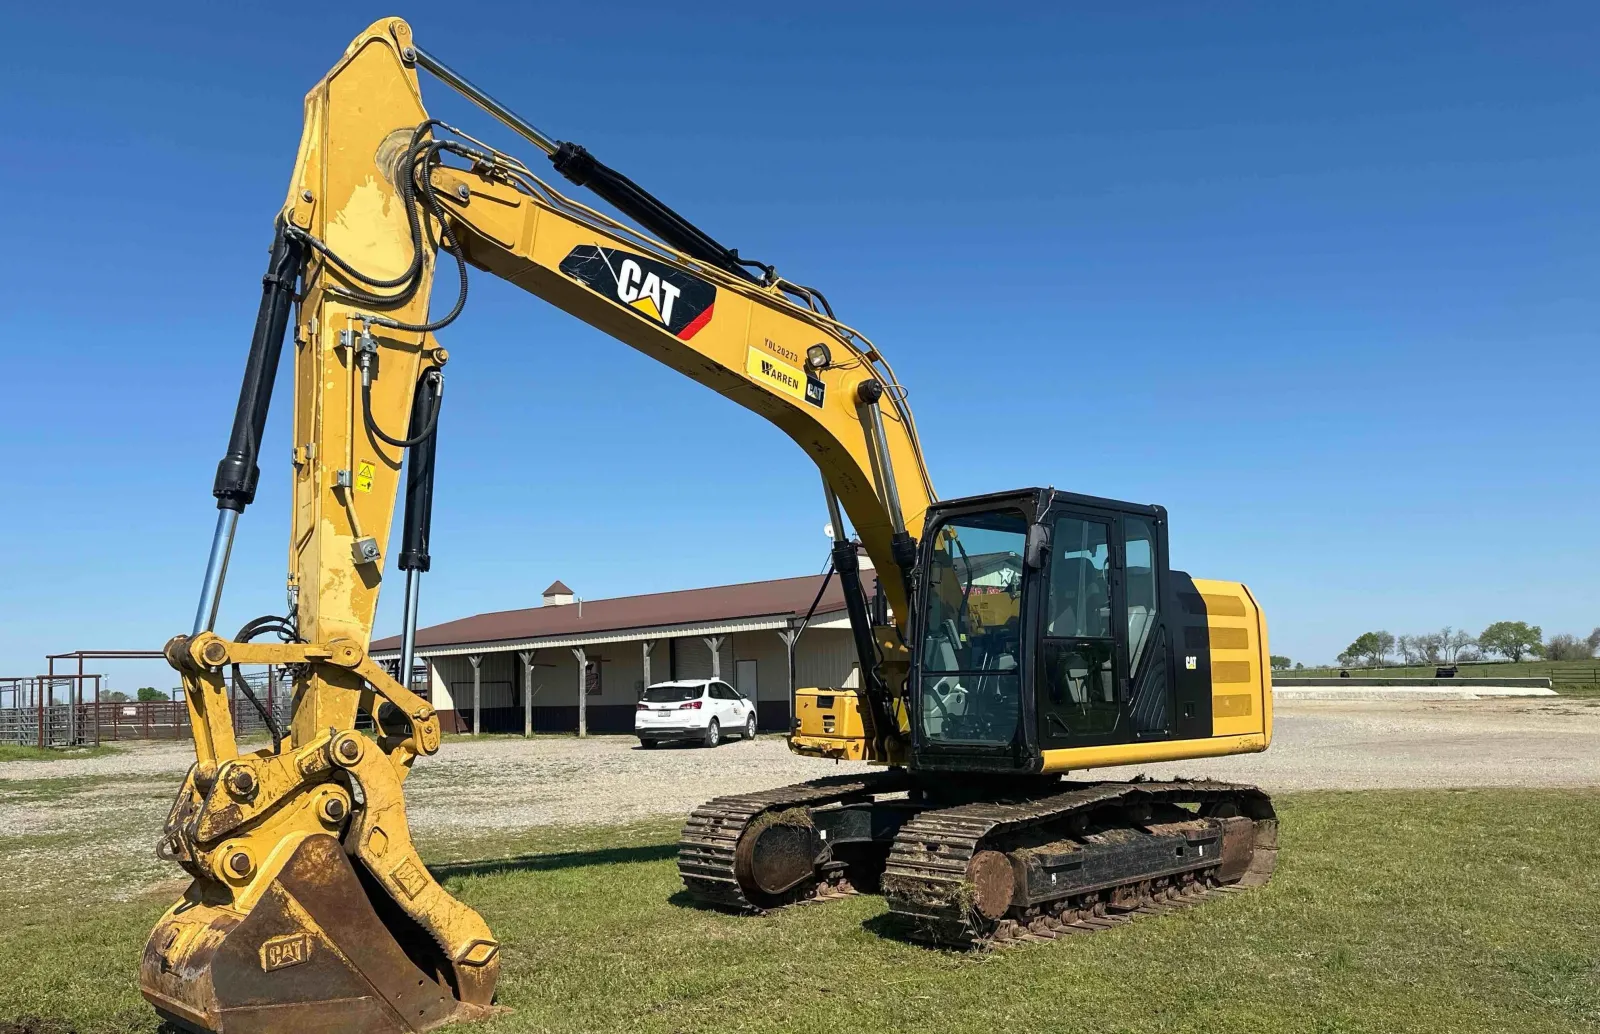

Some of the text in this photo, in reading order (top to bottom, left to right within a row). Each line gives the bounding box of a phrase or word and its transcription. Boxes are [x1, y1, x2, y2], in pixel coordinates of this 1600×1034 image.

[617, 259, 681, 327] CAT
[807, 383, 824, 401] CAT
[1185, 655, 1197, 670] CAT
[269, 940, 303, 967] CAT
